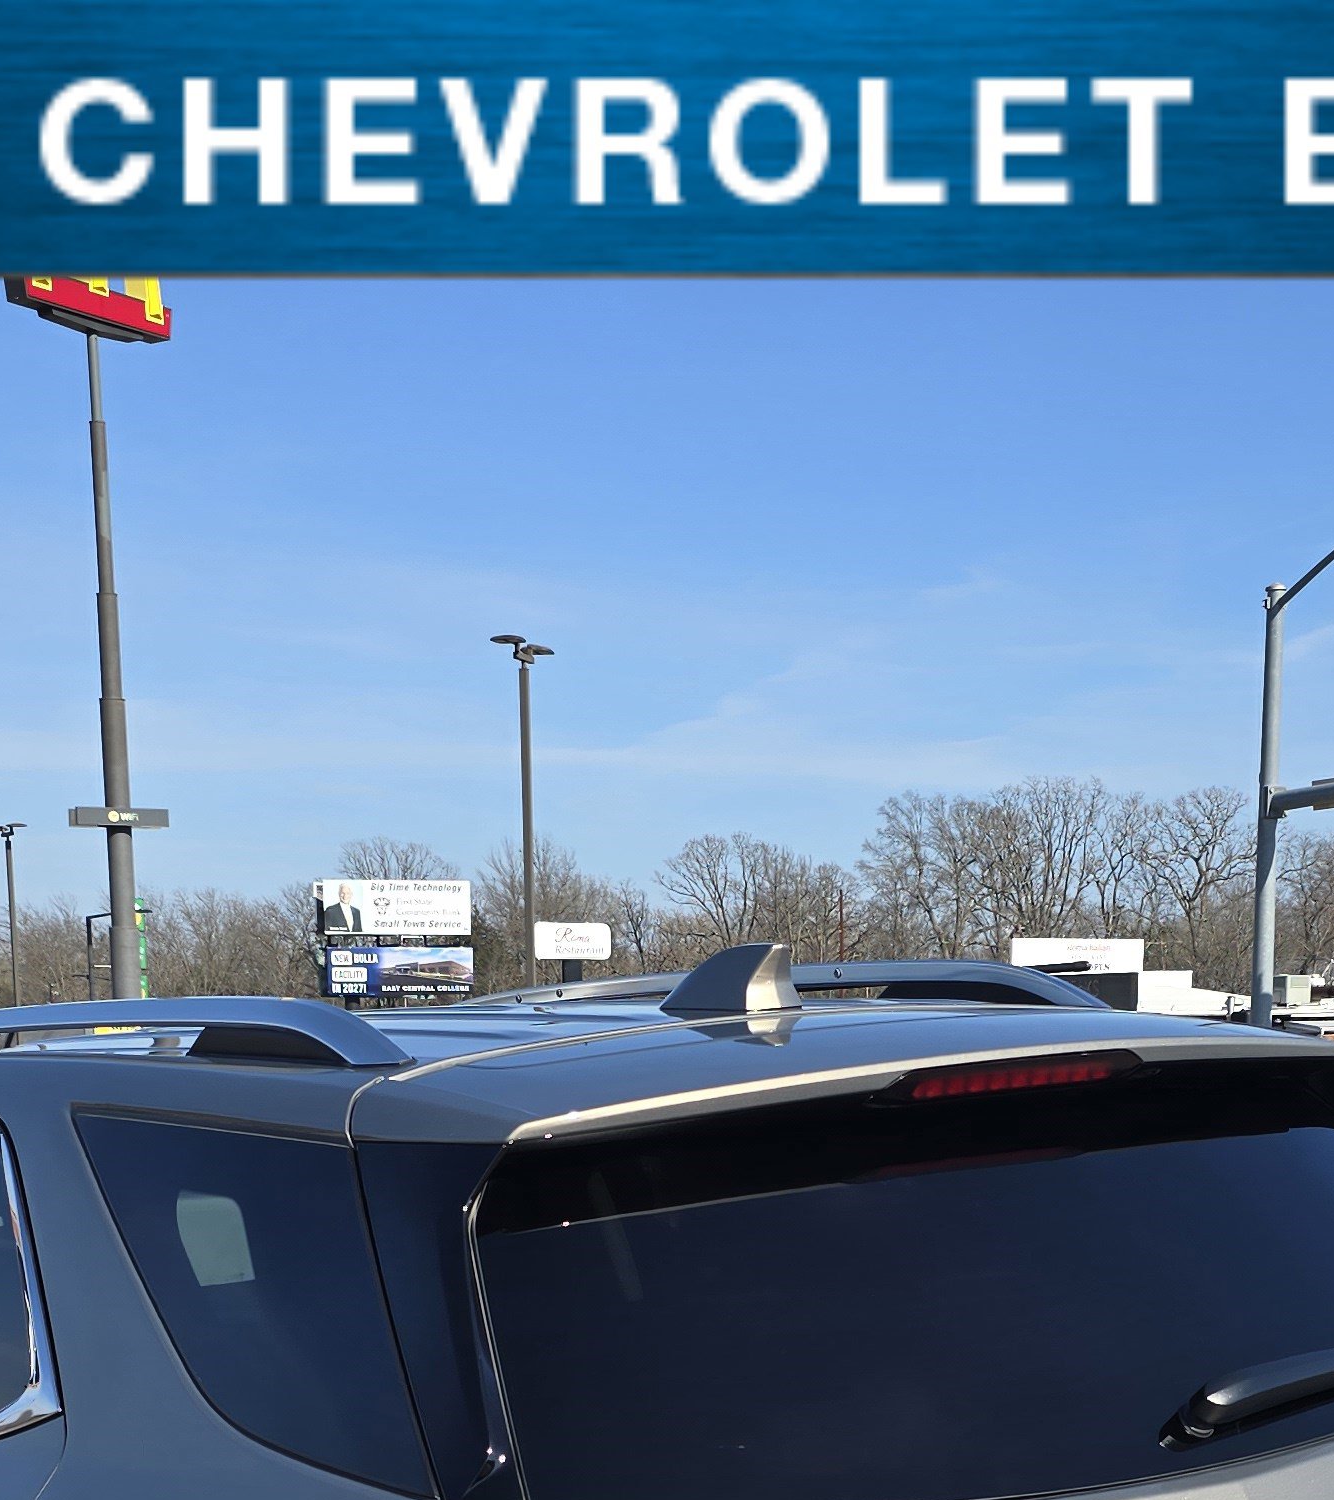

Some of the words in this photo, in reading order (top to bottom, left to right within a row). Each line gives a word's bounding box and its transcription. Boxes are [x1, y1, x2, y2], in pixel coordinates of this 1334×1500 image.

[371, 883, 385, 892] Big
[388, 883, 409, 891] Time
[413, 883, 462, 893] Technology
[374, 920, 400, 928] Small
[428, 920, 462, 928] Service
